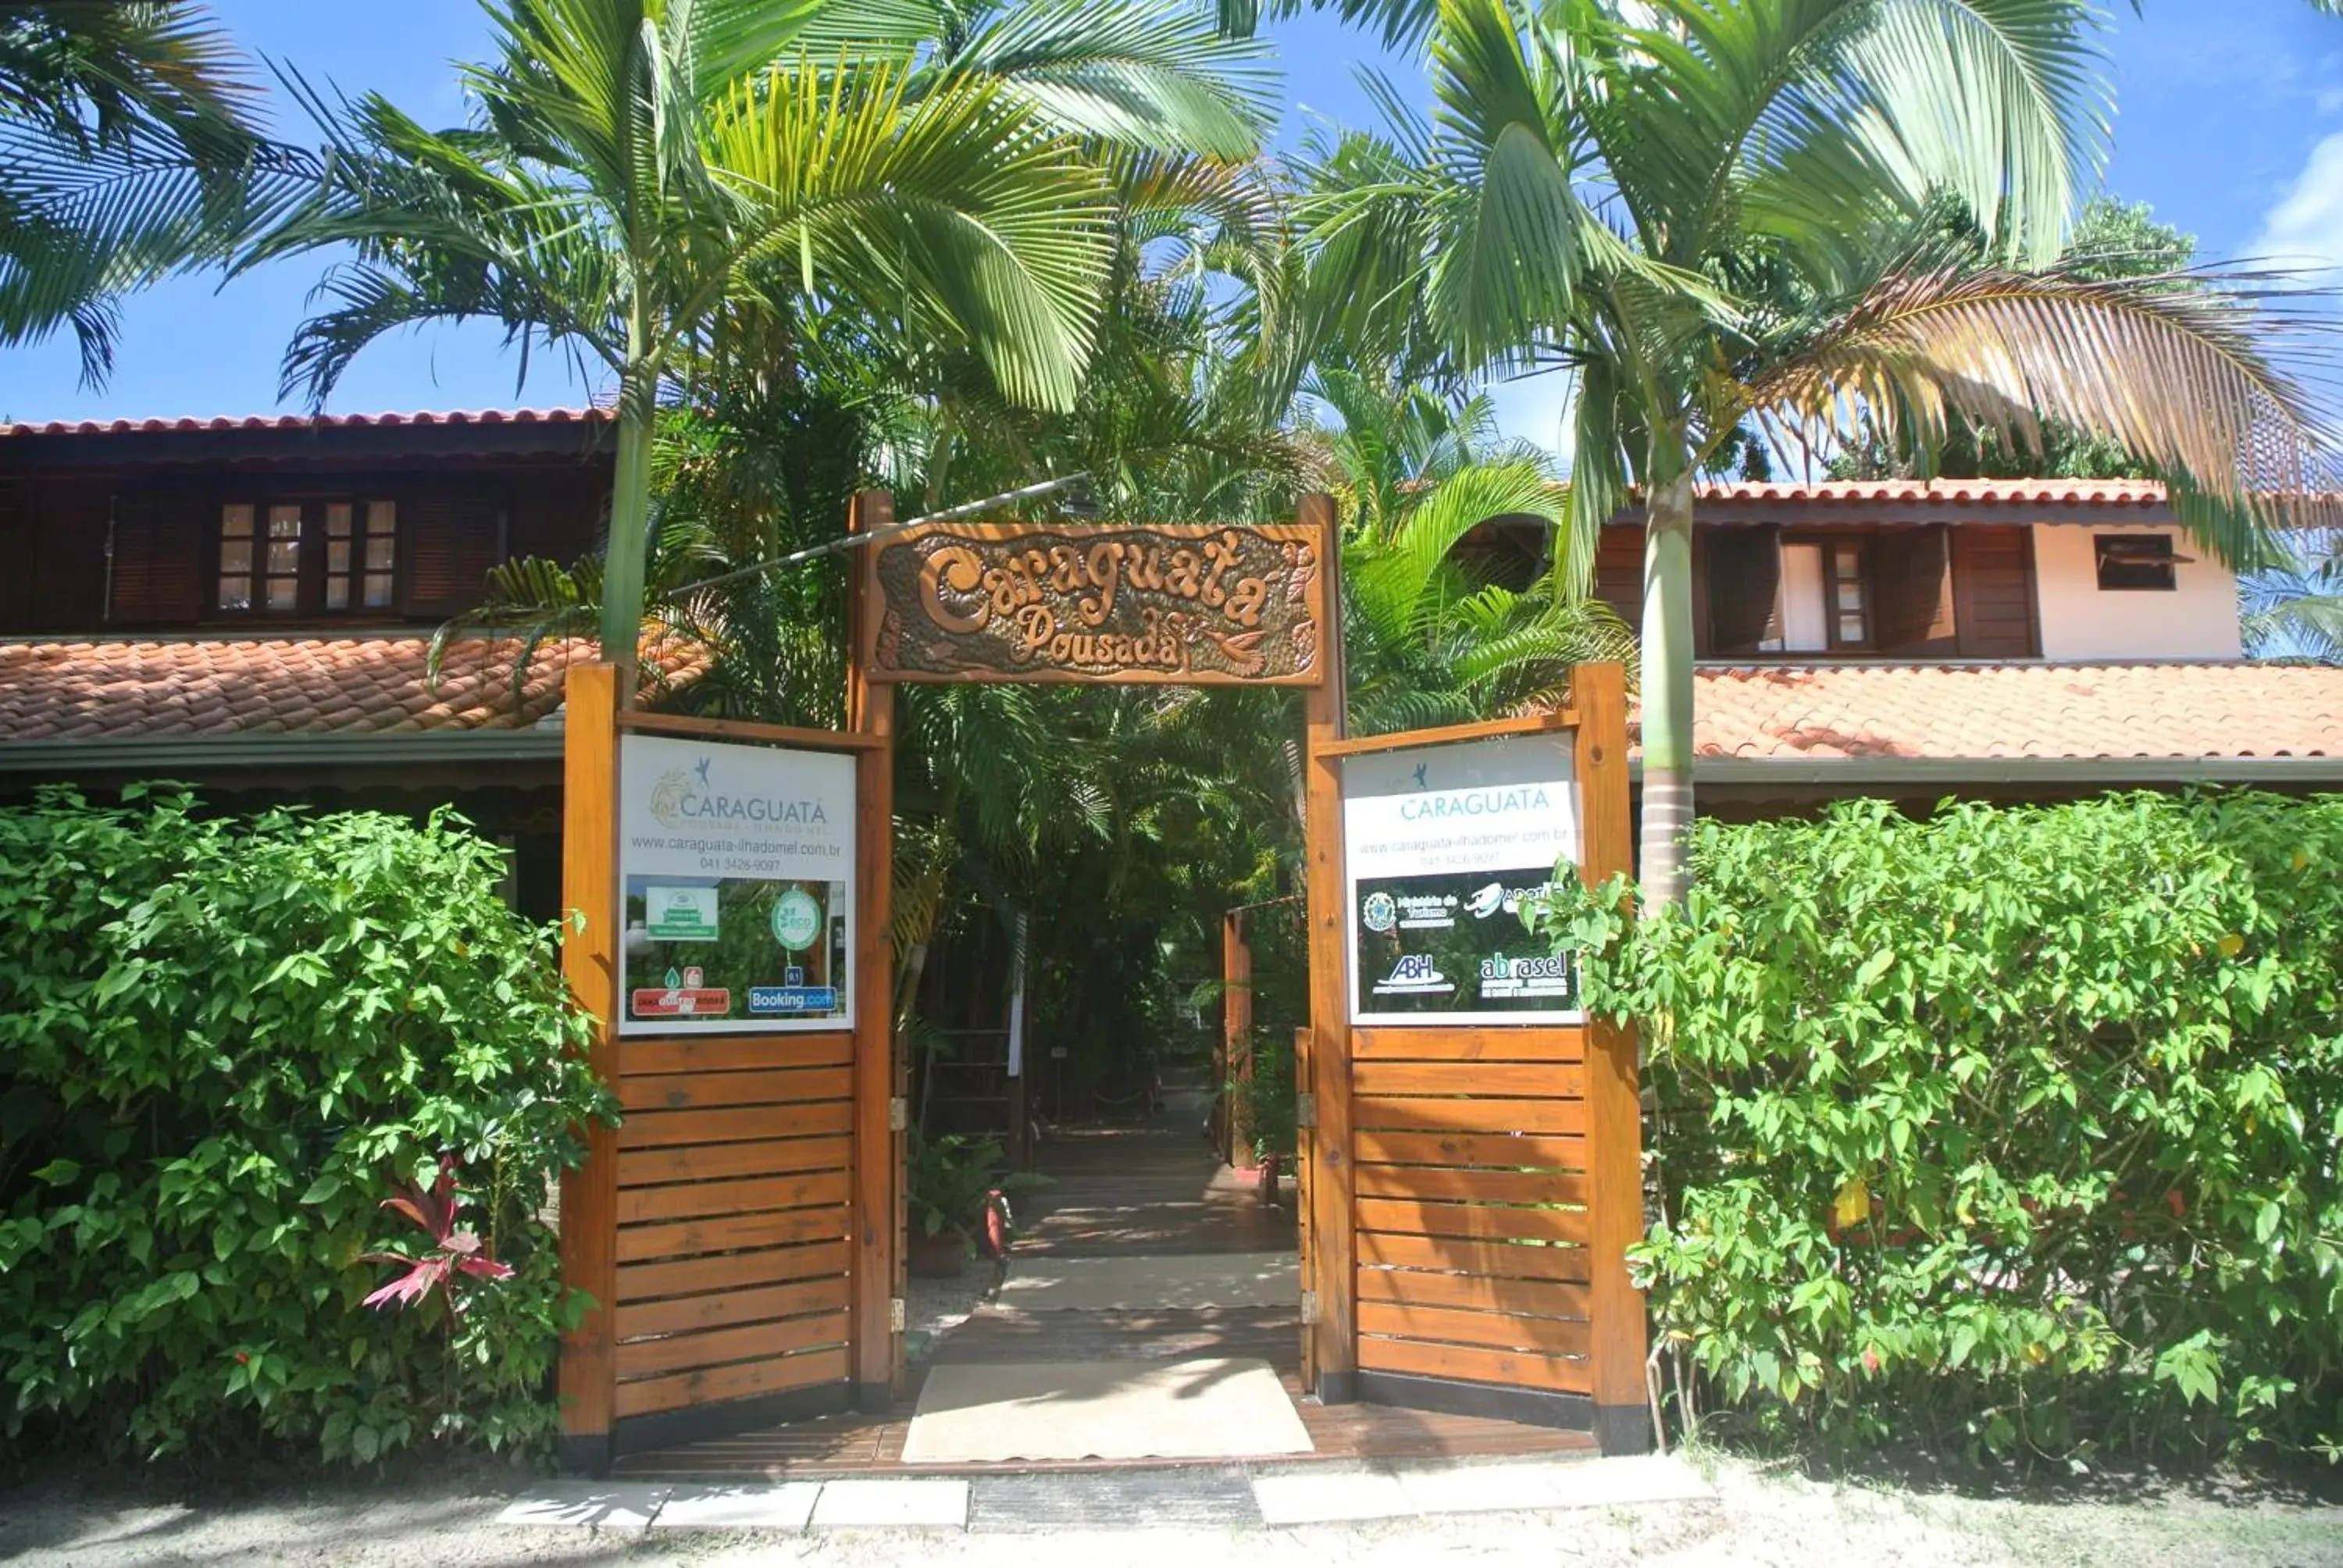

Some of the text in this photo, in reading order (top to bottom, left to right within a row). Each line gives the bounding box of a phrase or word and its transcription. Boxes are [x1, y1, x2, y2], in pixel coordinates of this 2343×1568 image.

[919, 530, 1268, 634] Caraguata
[1013, 605, 1179, 664] Pousada
[679, 794, 827, 825] CARAGUATÁ
